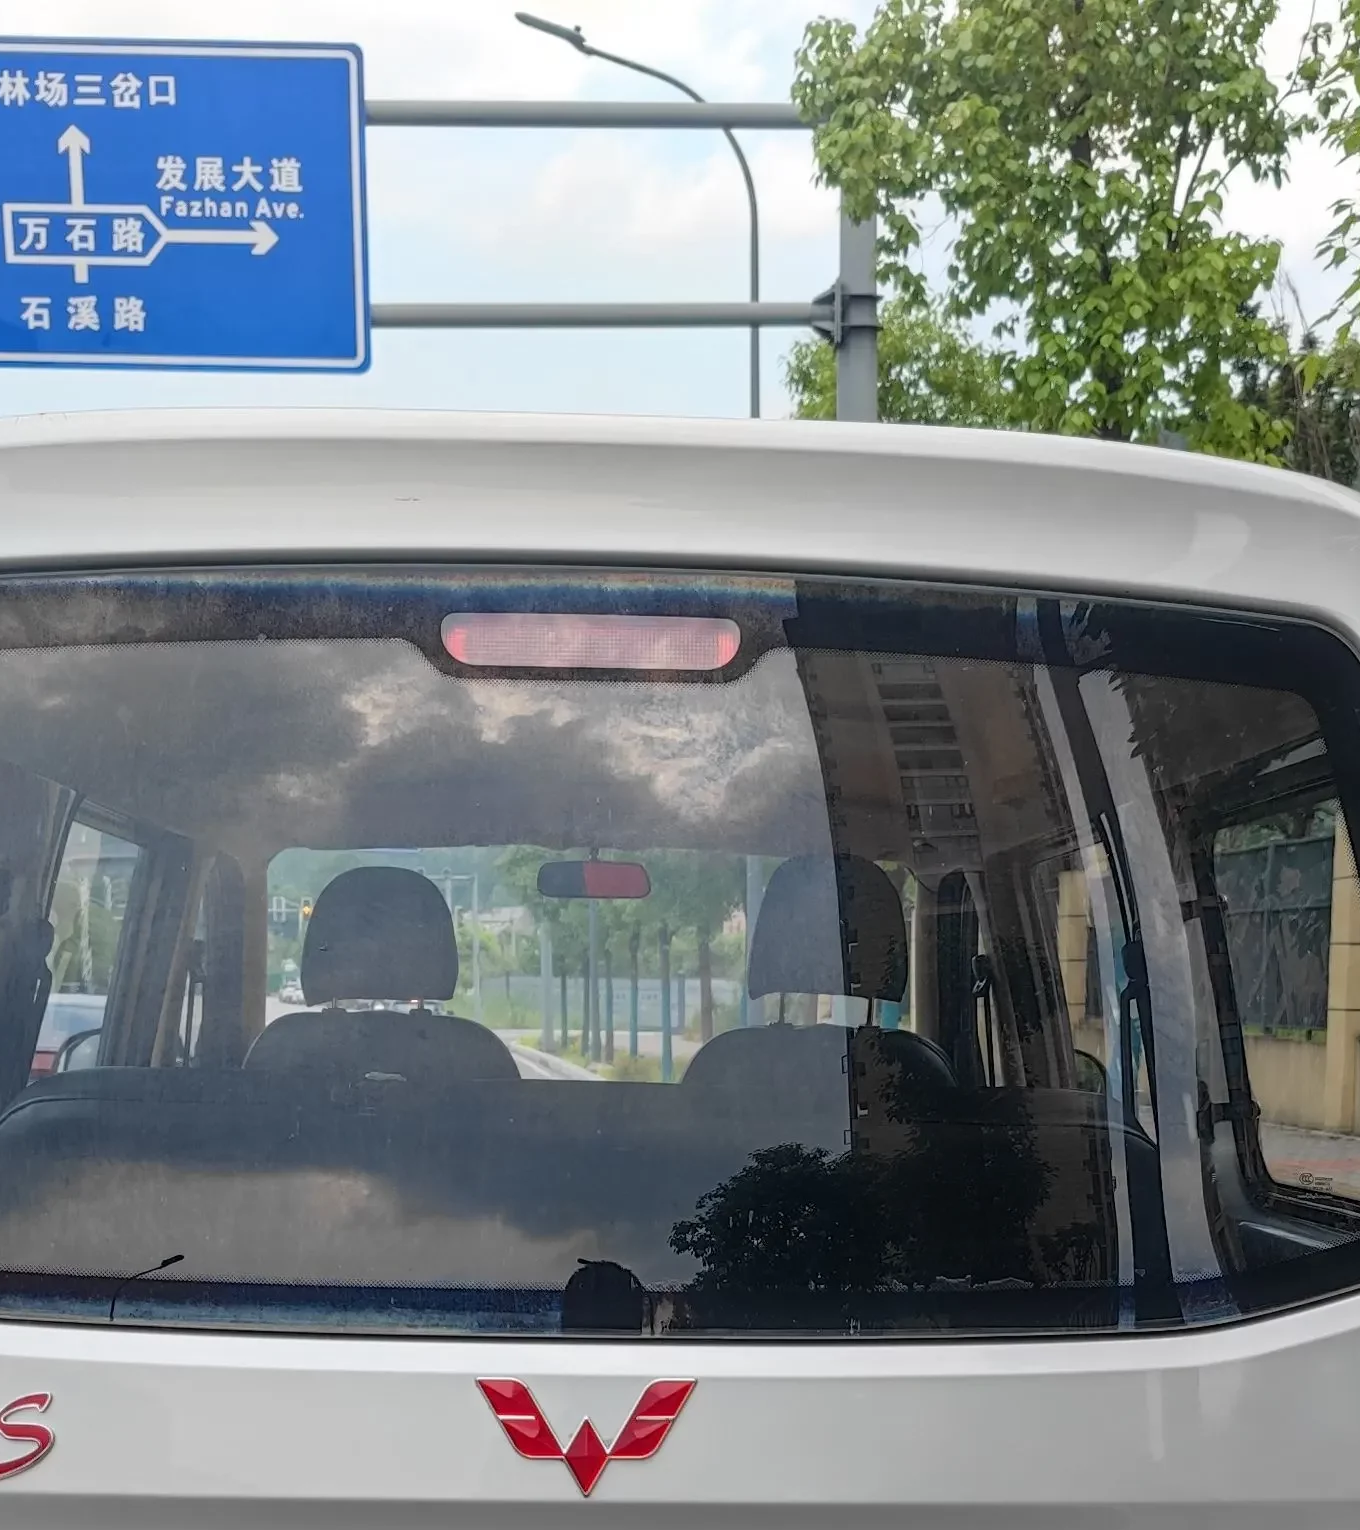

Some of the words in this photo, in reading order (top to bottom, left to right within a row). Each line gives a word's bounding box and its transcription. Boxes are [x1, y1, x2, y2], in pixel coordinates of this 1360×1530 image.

[156, 155, 304, 193] 发展大道
[160, 196, 248, 218] Fazhan
[255, 198, 305, 219] Ave.
[18, 217, 146, 253] 万石路
[20, 295, 147, 332] 石溪路
